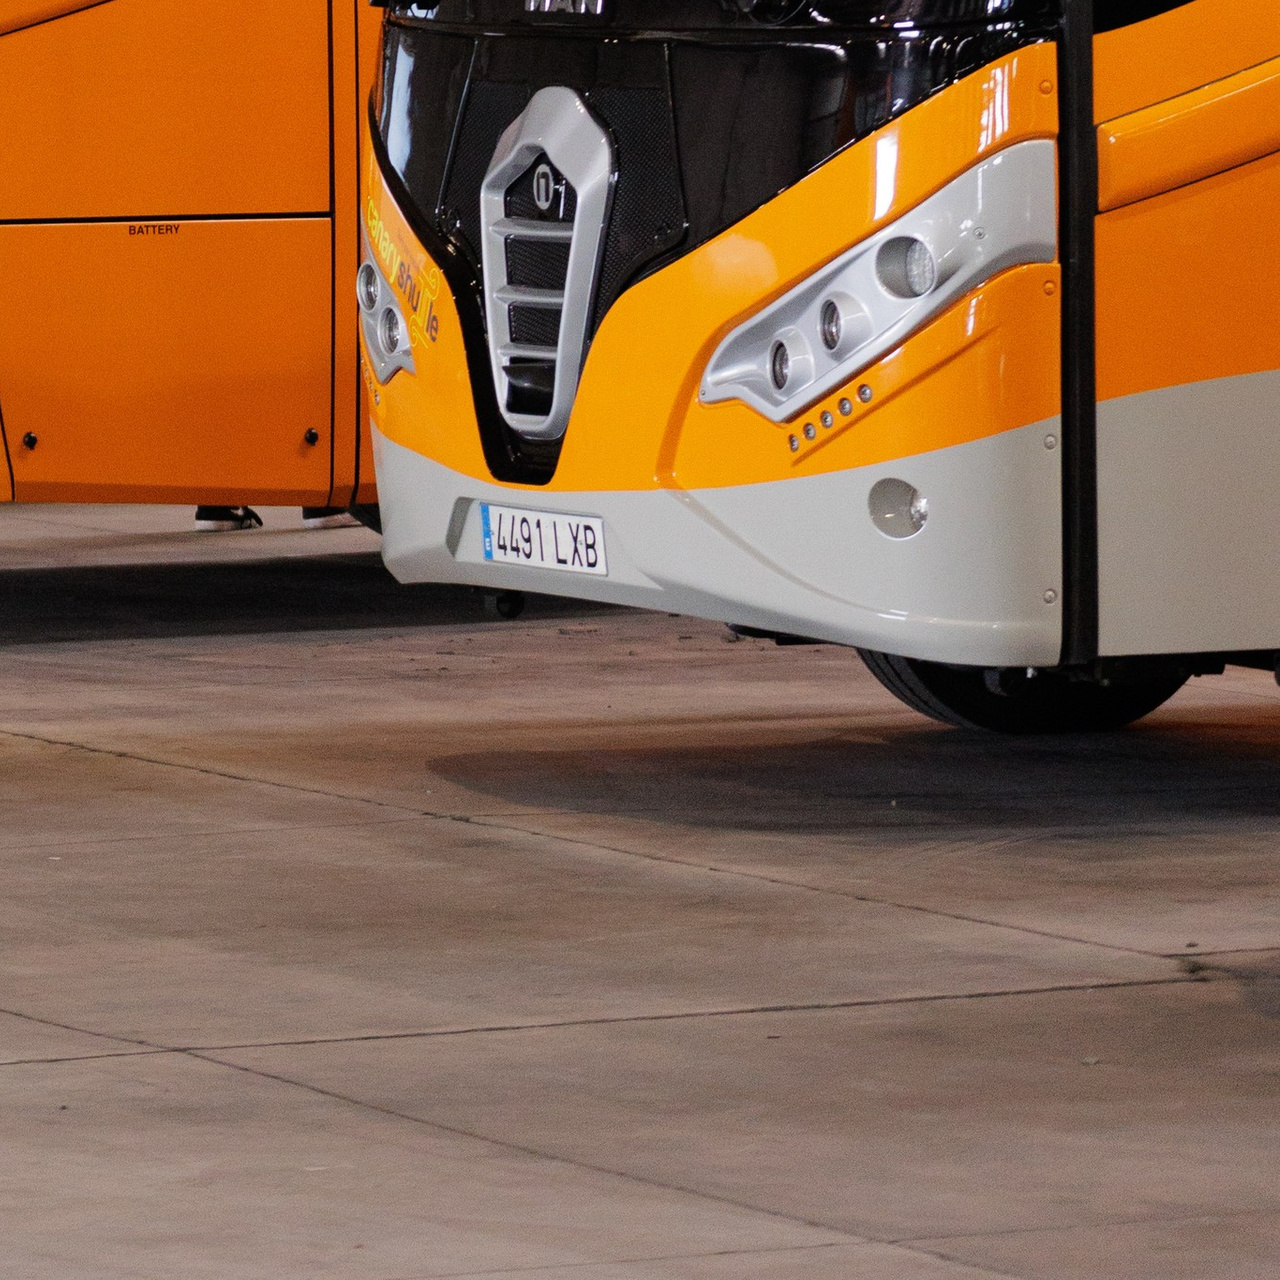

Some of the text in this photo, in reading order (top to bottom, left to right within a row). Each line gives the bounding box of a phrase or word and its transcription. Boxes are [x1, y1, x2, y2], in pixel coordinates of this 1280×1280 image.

[128, 224, 180, 235] BATTERY
[497, 513, 544, 561] 4491
[553, 521, 598, 568] LXB
